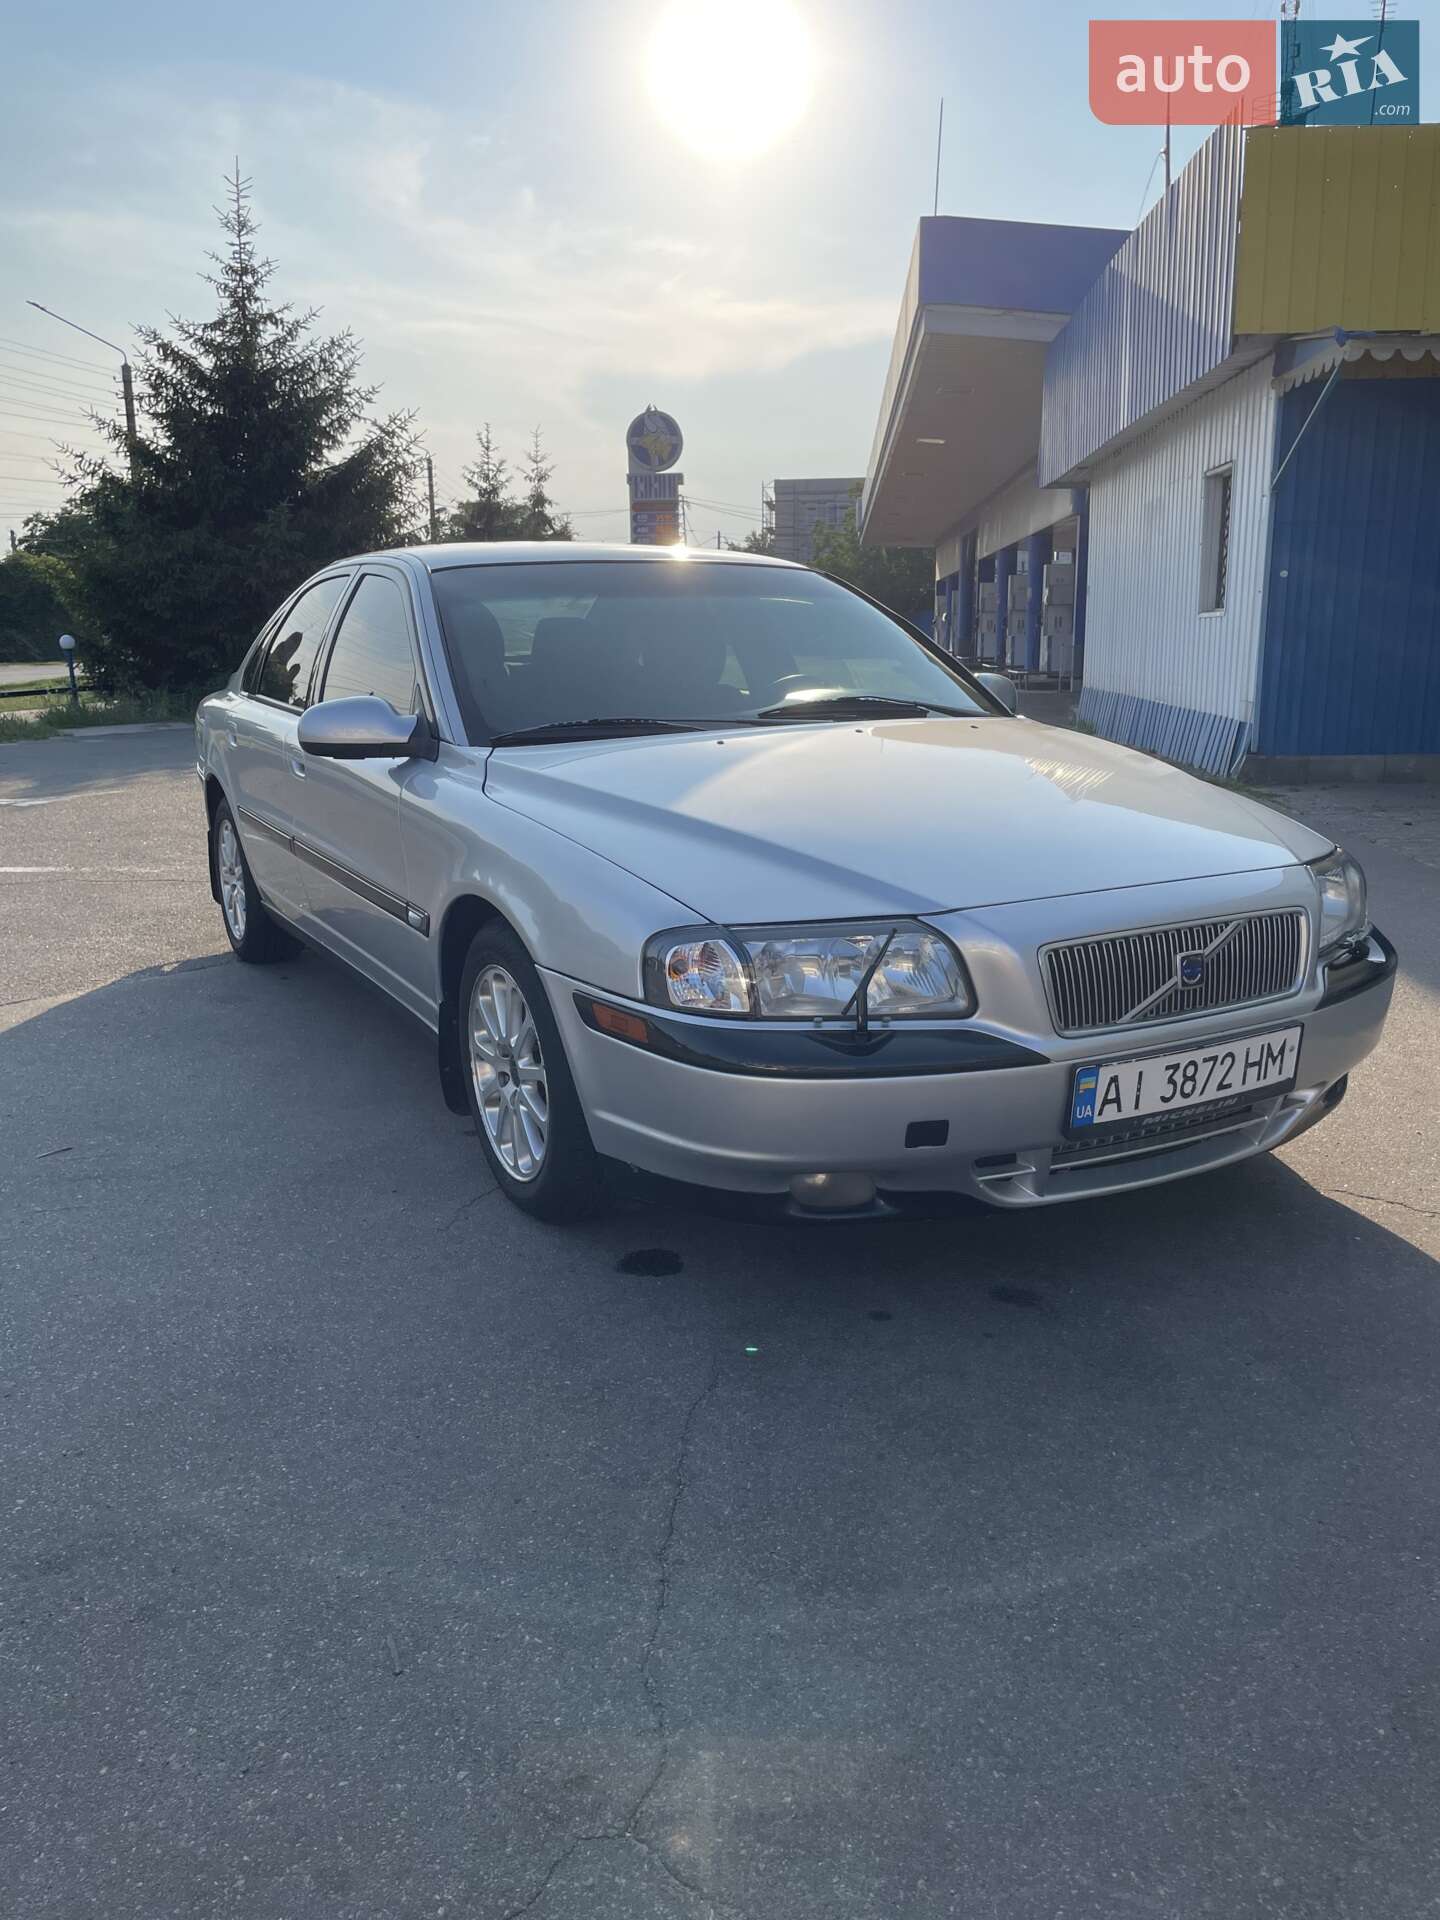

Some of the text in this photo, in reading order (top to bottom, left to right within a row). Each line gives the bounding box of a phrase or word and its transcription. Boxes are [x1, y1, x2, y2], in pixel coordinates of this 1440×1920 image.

[1097, 1038, 1287, 1116] AI 3872 HM
[1076, 1105, 1092, 1119] UA
